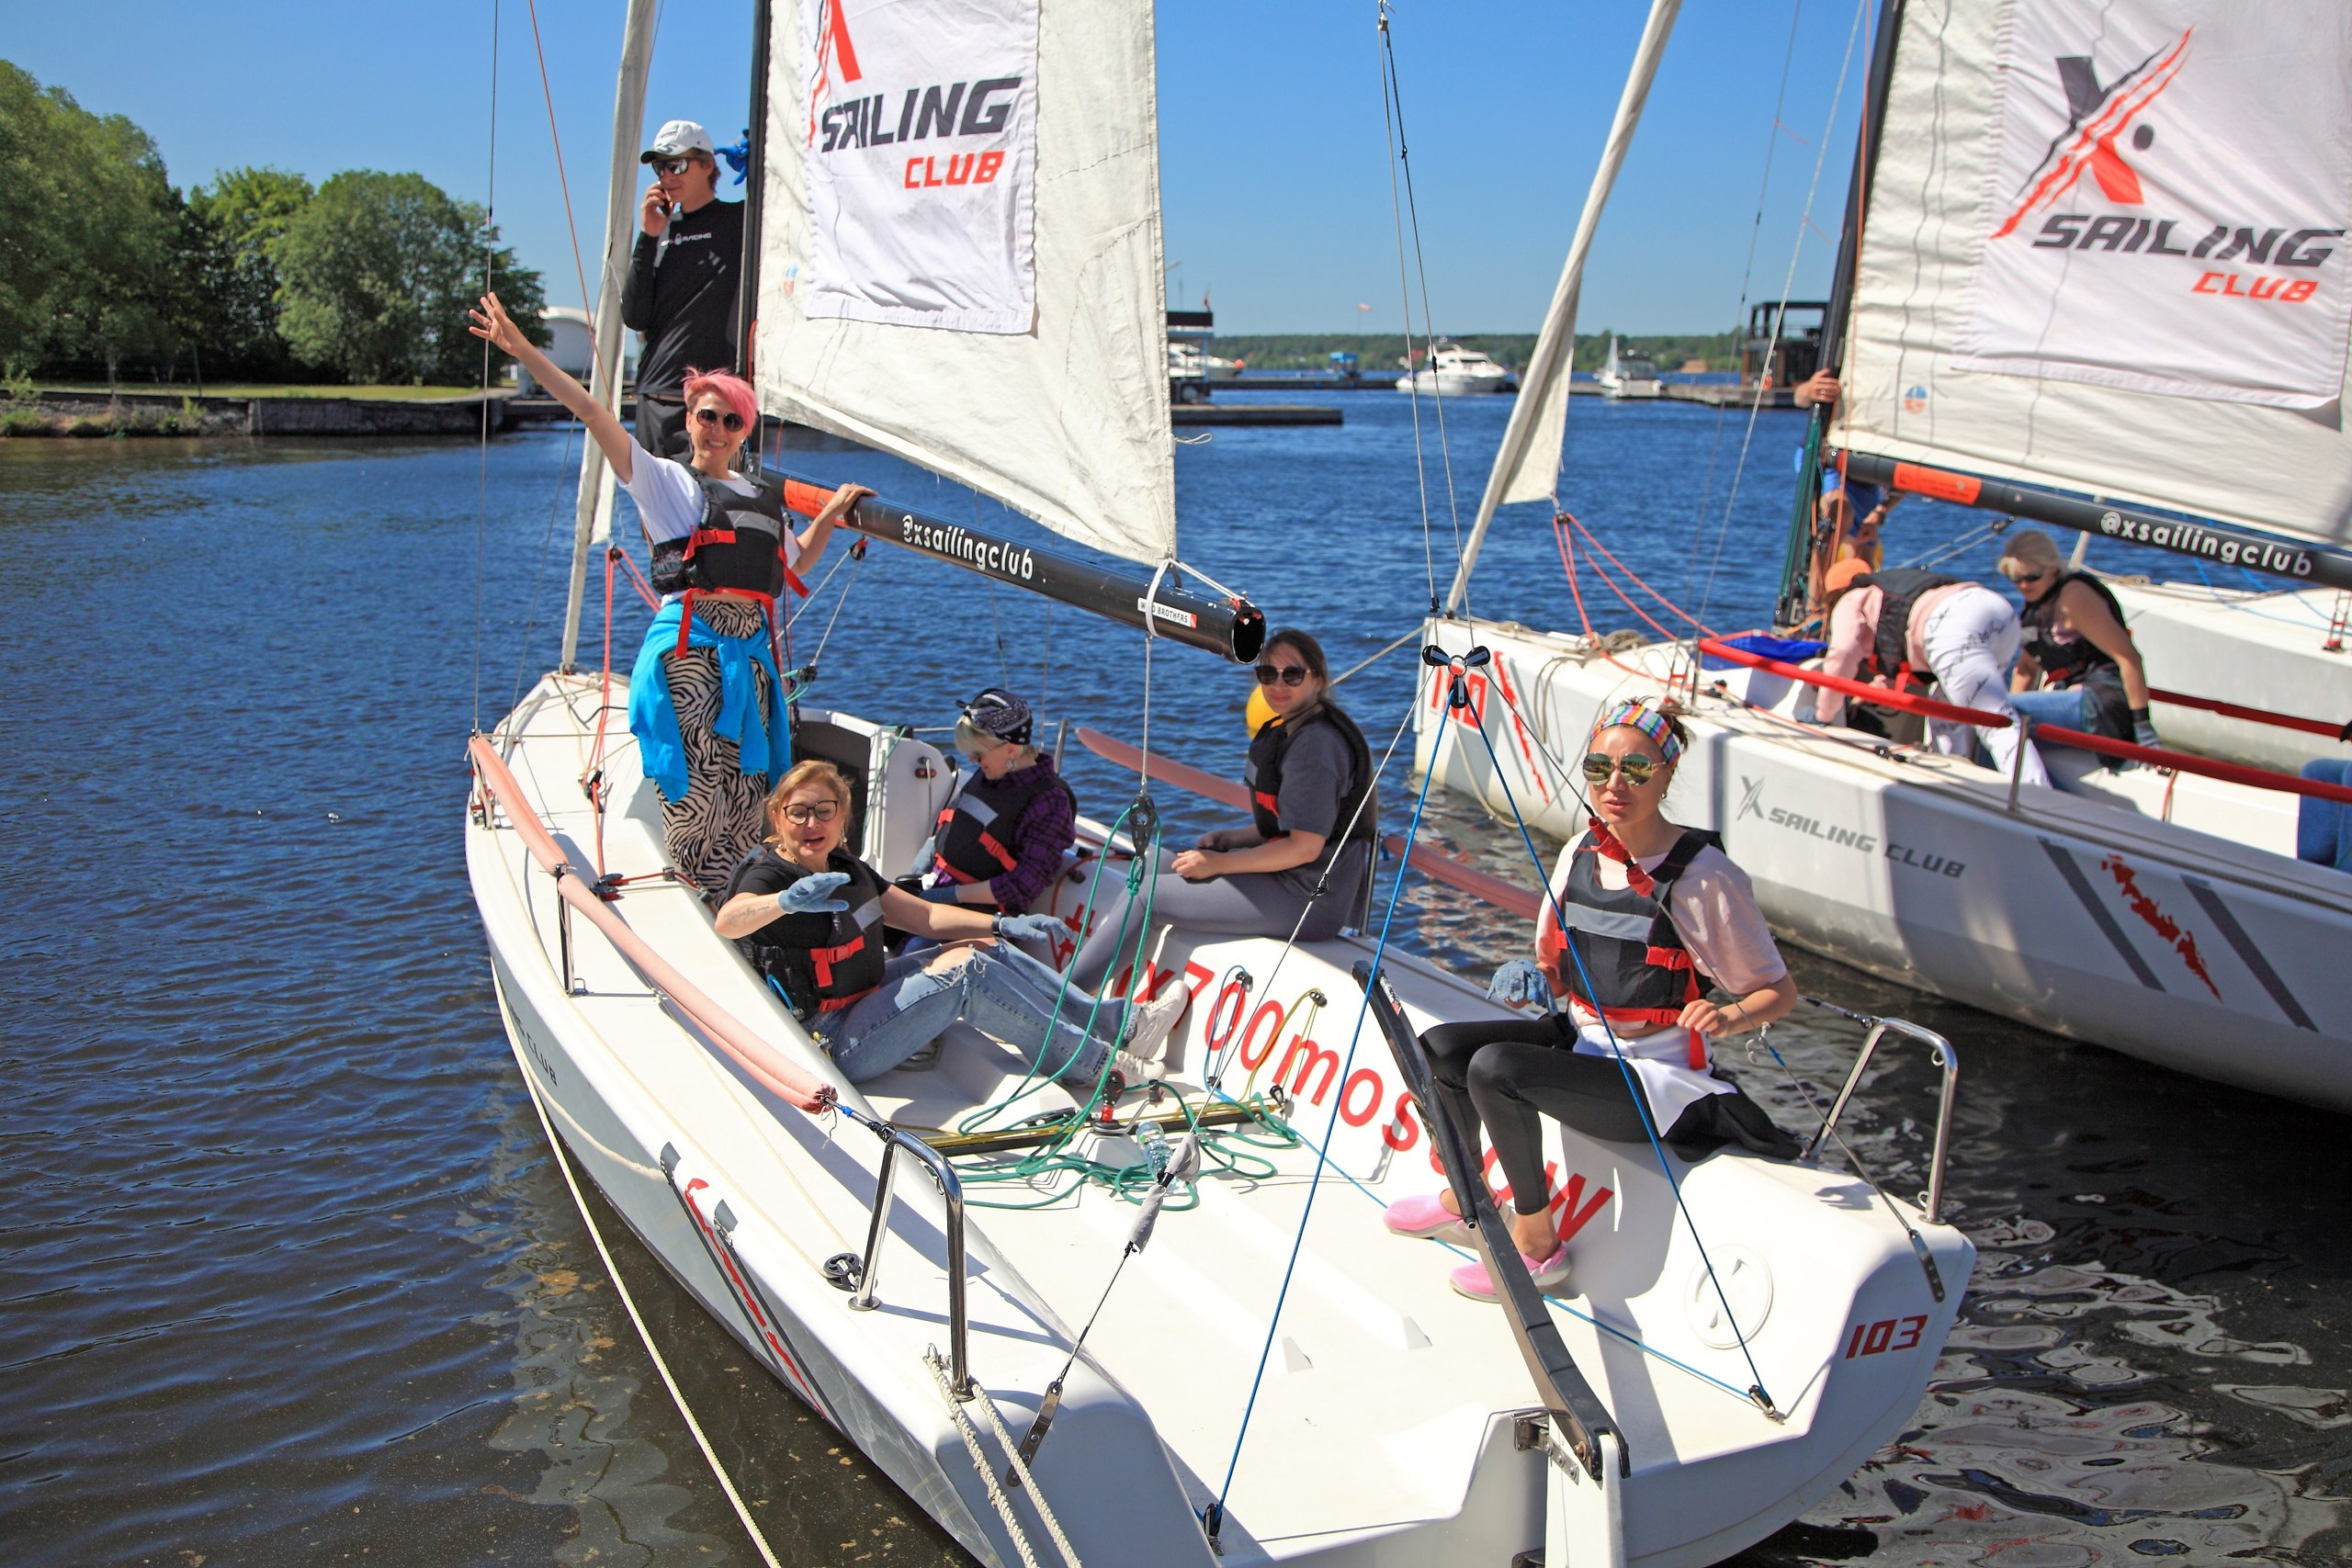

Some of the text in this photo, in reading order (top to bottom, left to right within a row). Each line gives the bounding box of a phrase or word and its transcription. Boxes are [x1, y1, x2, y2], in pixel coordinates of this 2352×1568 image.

[821, 77, 1023, 153] SAILING
[905, 151, 1006, 189] CLUB
[2031, 215, 2347, 267] SAILING
[2191, 272, 2319, 303] CLUB
[902, 514, 1034, 580] @xsailingclub
[2100, 511, 2312, 576] @xsailingclub
[1140, 602, 1188, 623] WD BROTHERS
[1769, 807, 1877, 853] SAILING
[1884, 843, 1966, 879] CLUB
[526, 1032, 558, 1087] CLUB
[1845, 1314, 1928, 1359] 103
